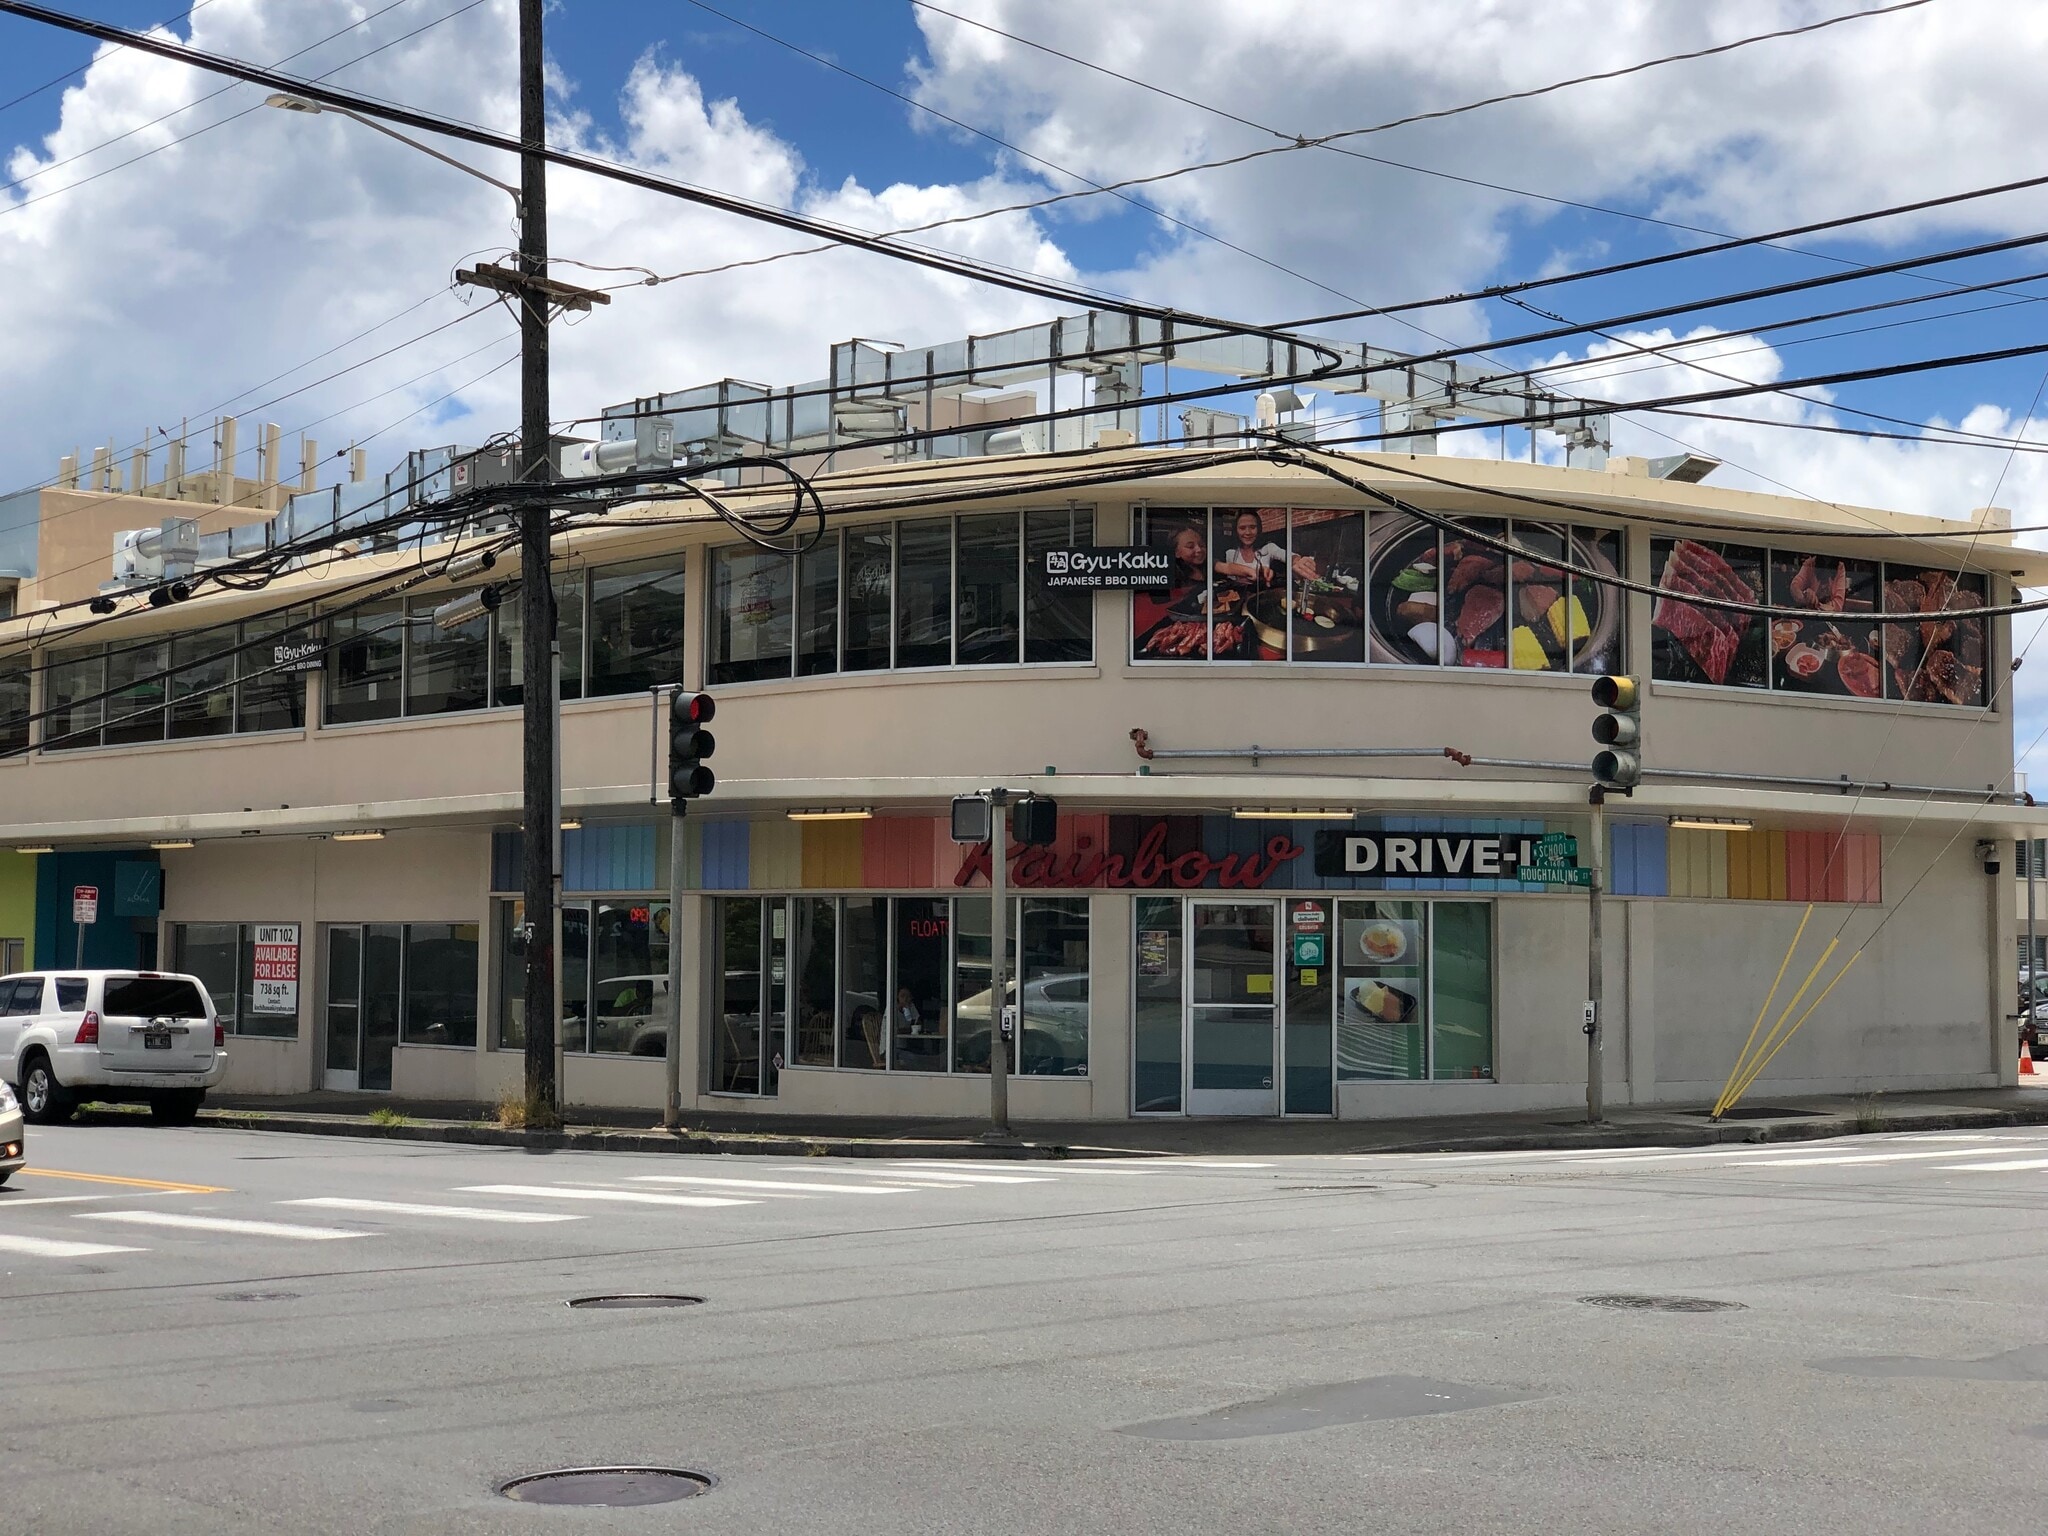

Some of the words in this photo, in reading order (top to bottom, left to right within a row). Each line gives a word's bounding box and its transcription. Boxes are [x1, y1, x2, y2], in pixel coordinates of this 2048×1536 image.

[1070, 552, 1169, 574] Gyu-Kaku
[1047, 576, 1102, 586] JAPANESE
[1105, 575, 1128, 585] BBQ
[1130, 575, 1168, 585] DINING
[1345, 837, 1542, 874] DRIVE-I
[1538, 842, 1568, 858] SCHOOL
[1521, 868, 1579, 882] HOUGHTAILING
[1582, 872, 1588, 880] ST
[260, 928, 278, 942] UNIT
[279, 928, 293, 942] 102
[911, 920, 950, 937] FLOAT
[255, 947, 297, 961] AVAILABLE
[255, 963, 271, 978] FOR
[272, 964, 296, 978] LEASE
[260, 983, 272, 995] 738
[273, 986, 281, 997] sq
[281, 983, 289, 995] ft.
